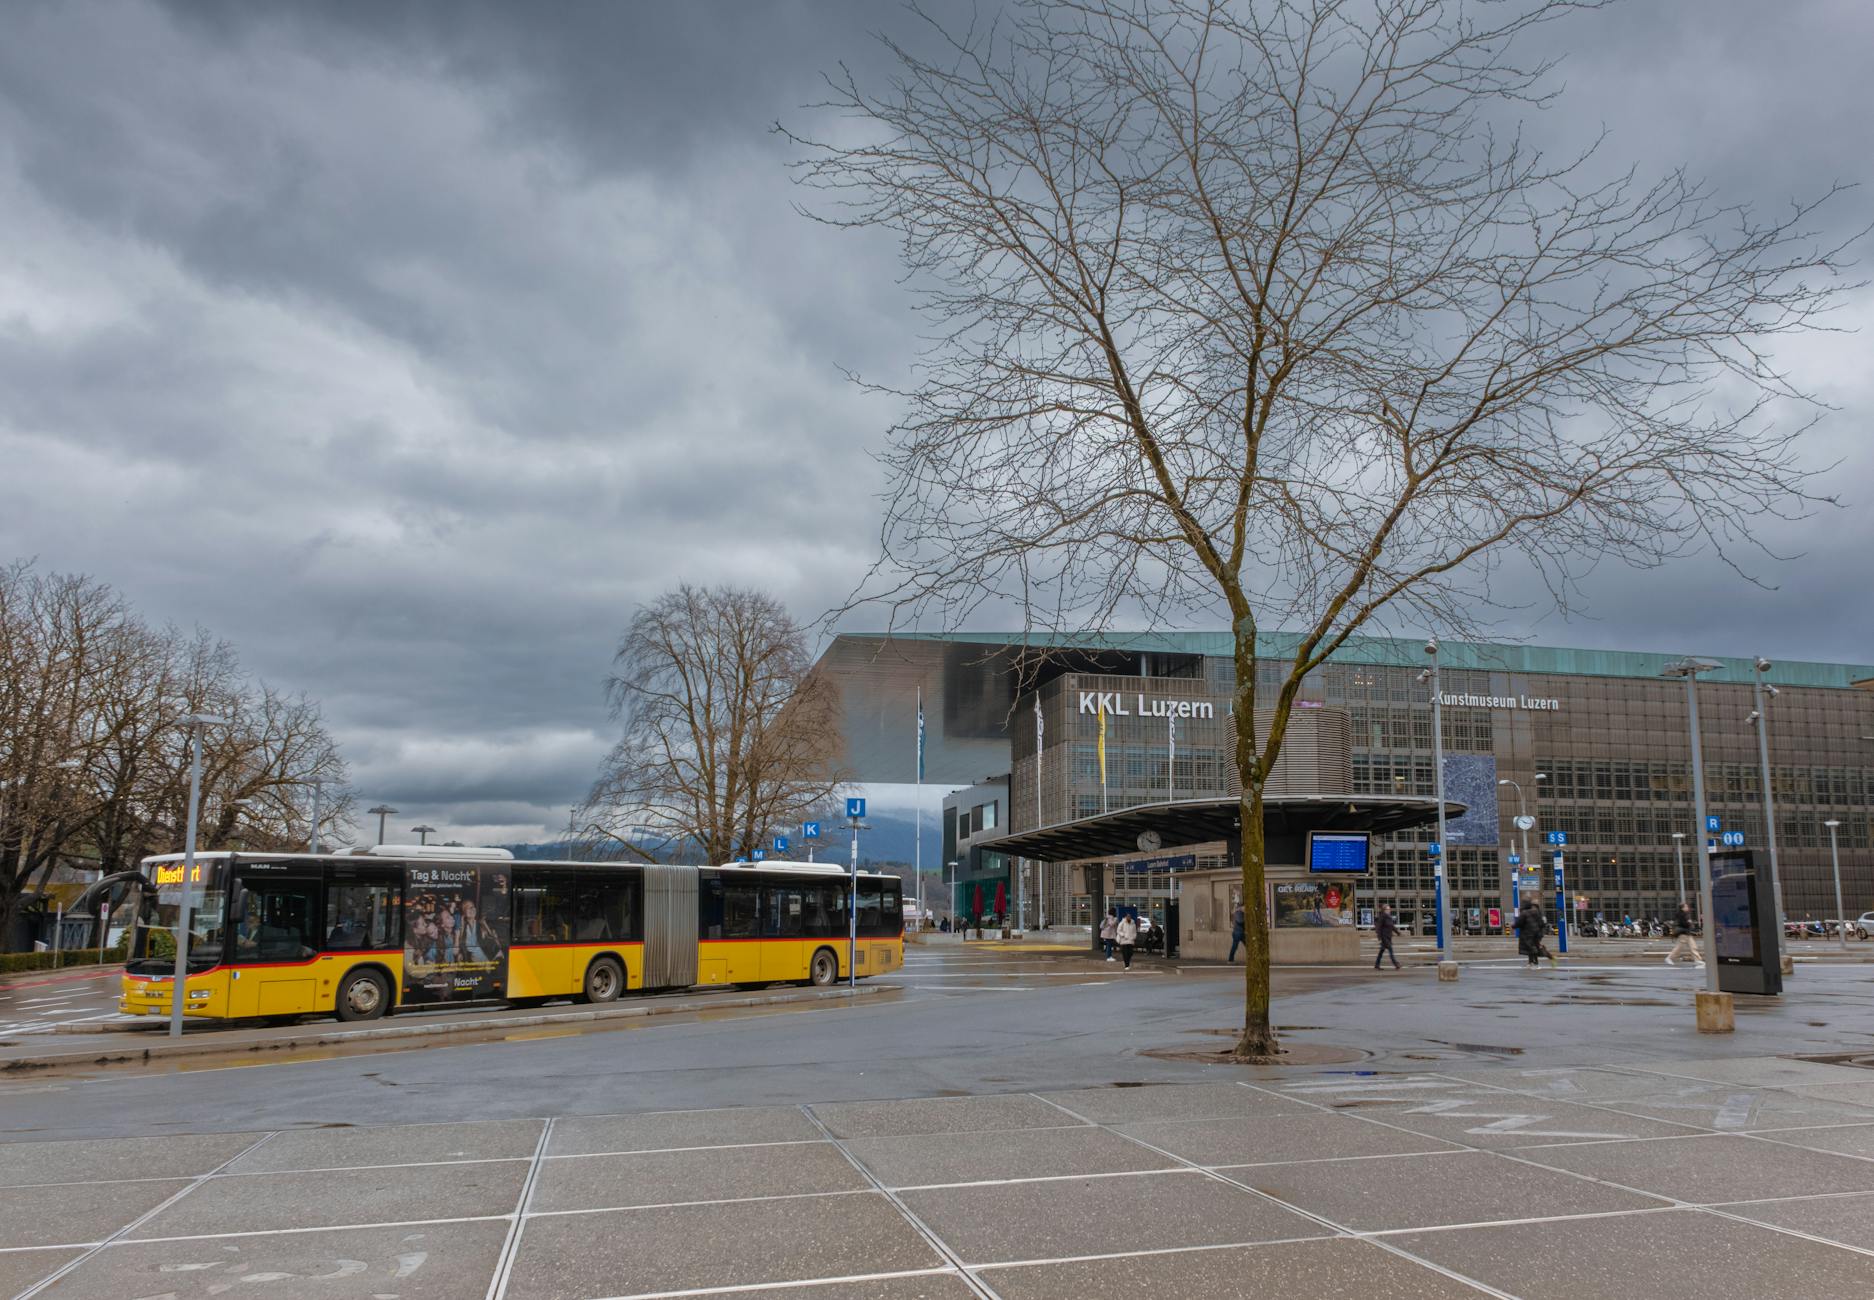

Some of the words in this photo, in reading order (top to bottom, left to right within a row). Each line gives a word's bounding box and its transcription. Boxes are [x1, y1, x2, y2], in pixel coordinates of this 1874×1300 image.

[1079, 692, 1129, 716] KKL
[1138, 694, 1213, 719] Luzern
[1521, 694, 1559, 710] Luzern
[157, 865, 200, 884] Dienstfrt
[410, 869, 430, 882] Tag
[431, 869, 440, 880] &
